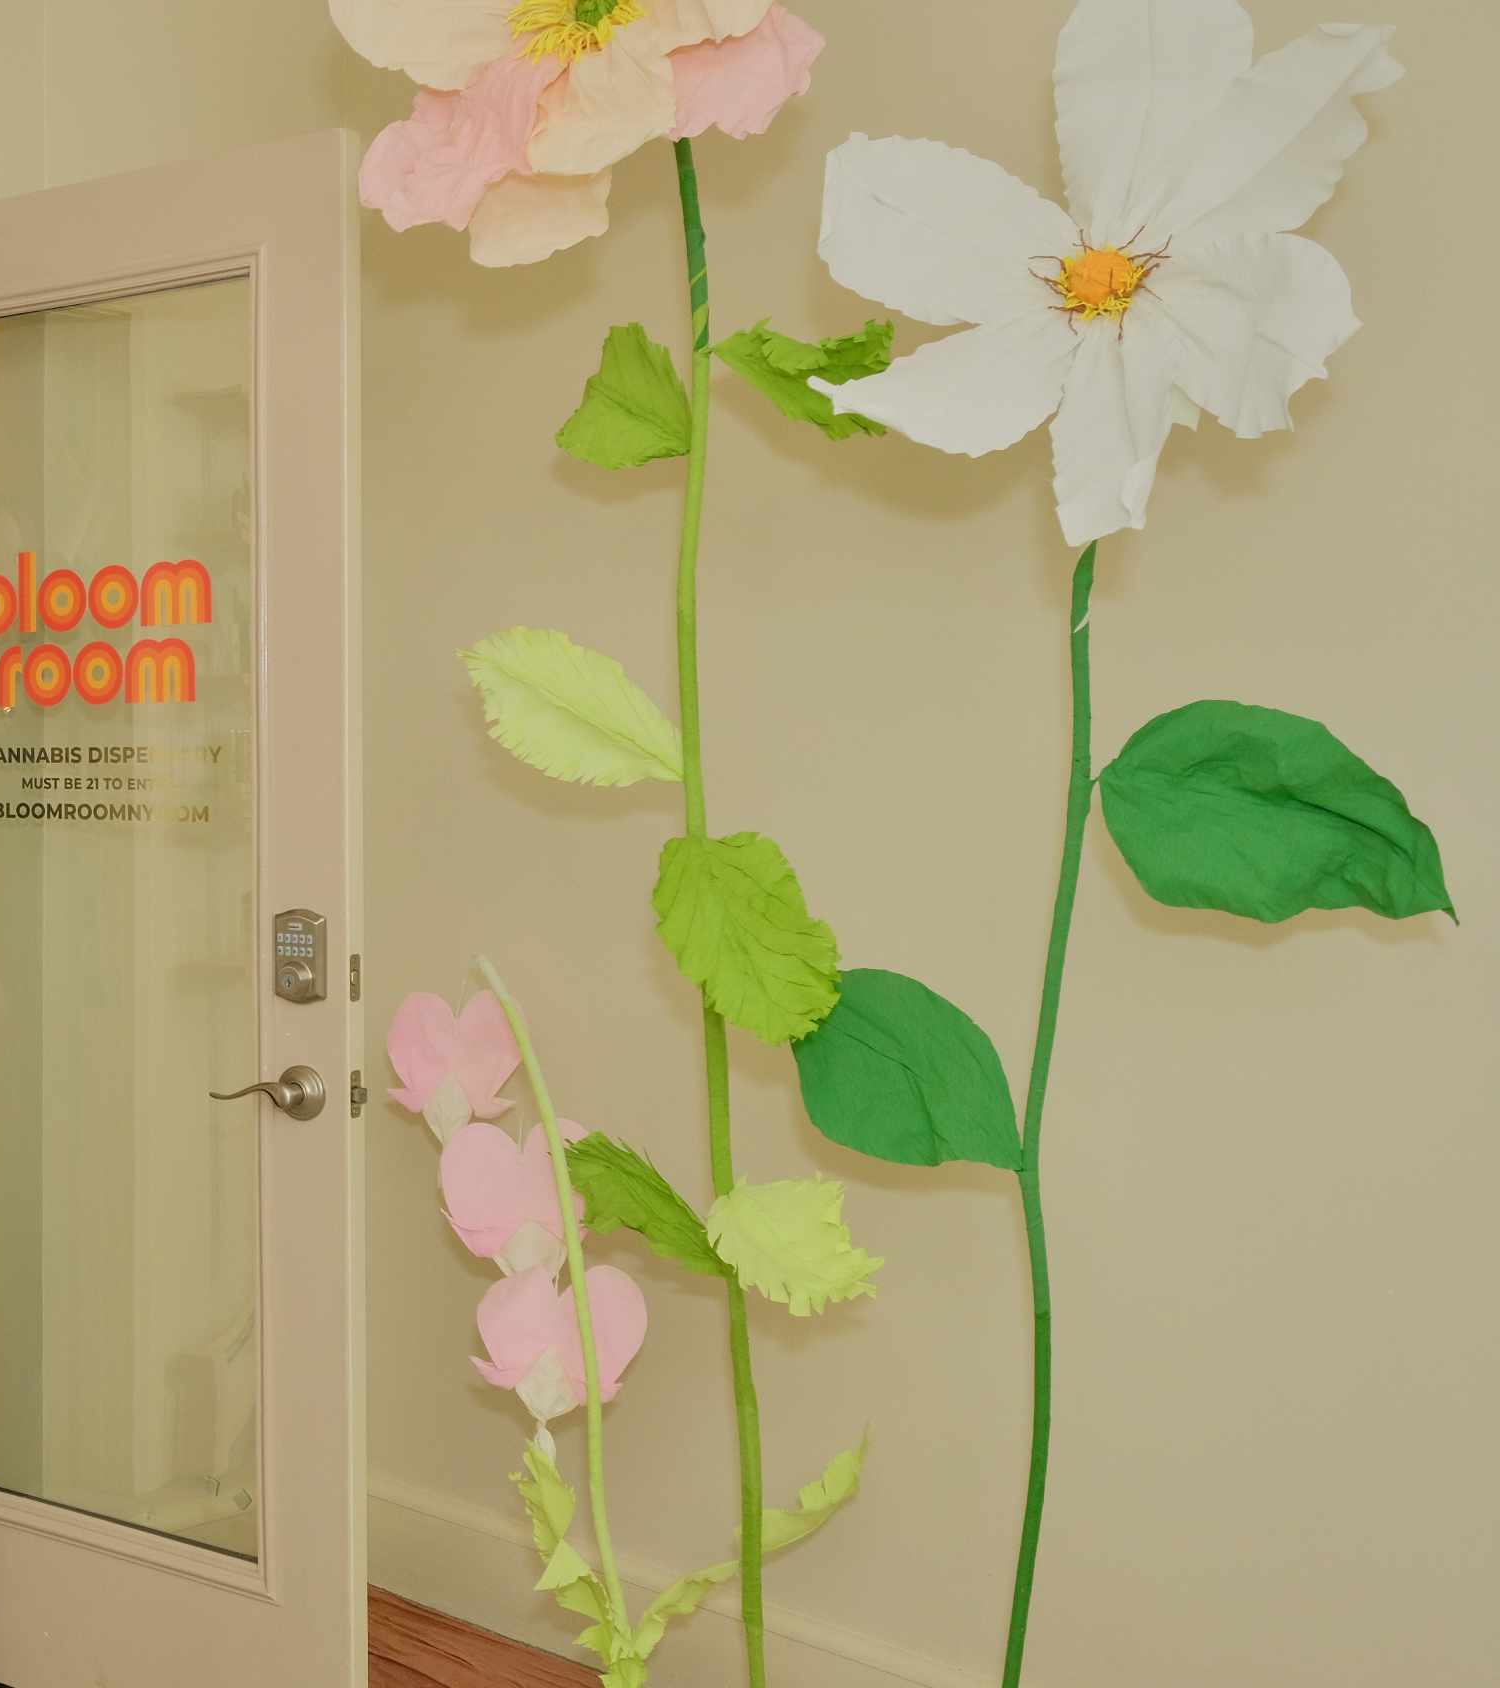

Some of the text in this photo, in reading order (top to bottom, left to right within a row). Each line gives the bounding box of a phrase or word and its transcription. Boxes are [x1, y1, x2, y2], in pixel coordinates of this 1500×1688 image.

[87, 746, 222, 764] DISPEY
[21, 777, 60, 790] MUST
[64, 777, 82, 790] BE
[86, 777, 100, 790] 21
[103, 777, 124, 790] TO
